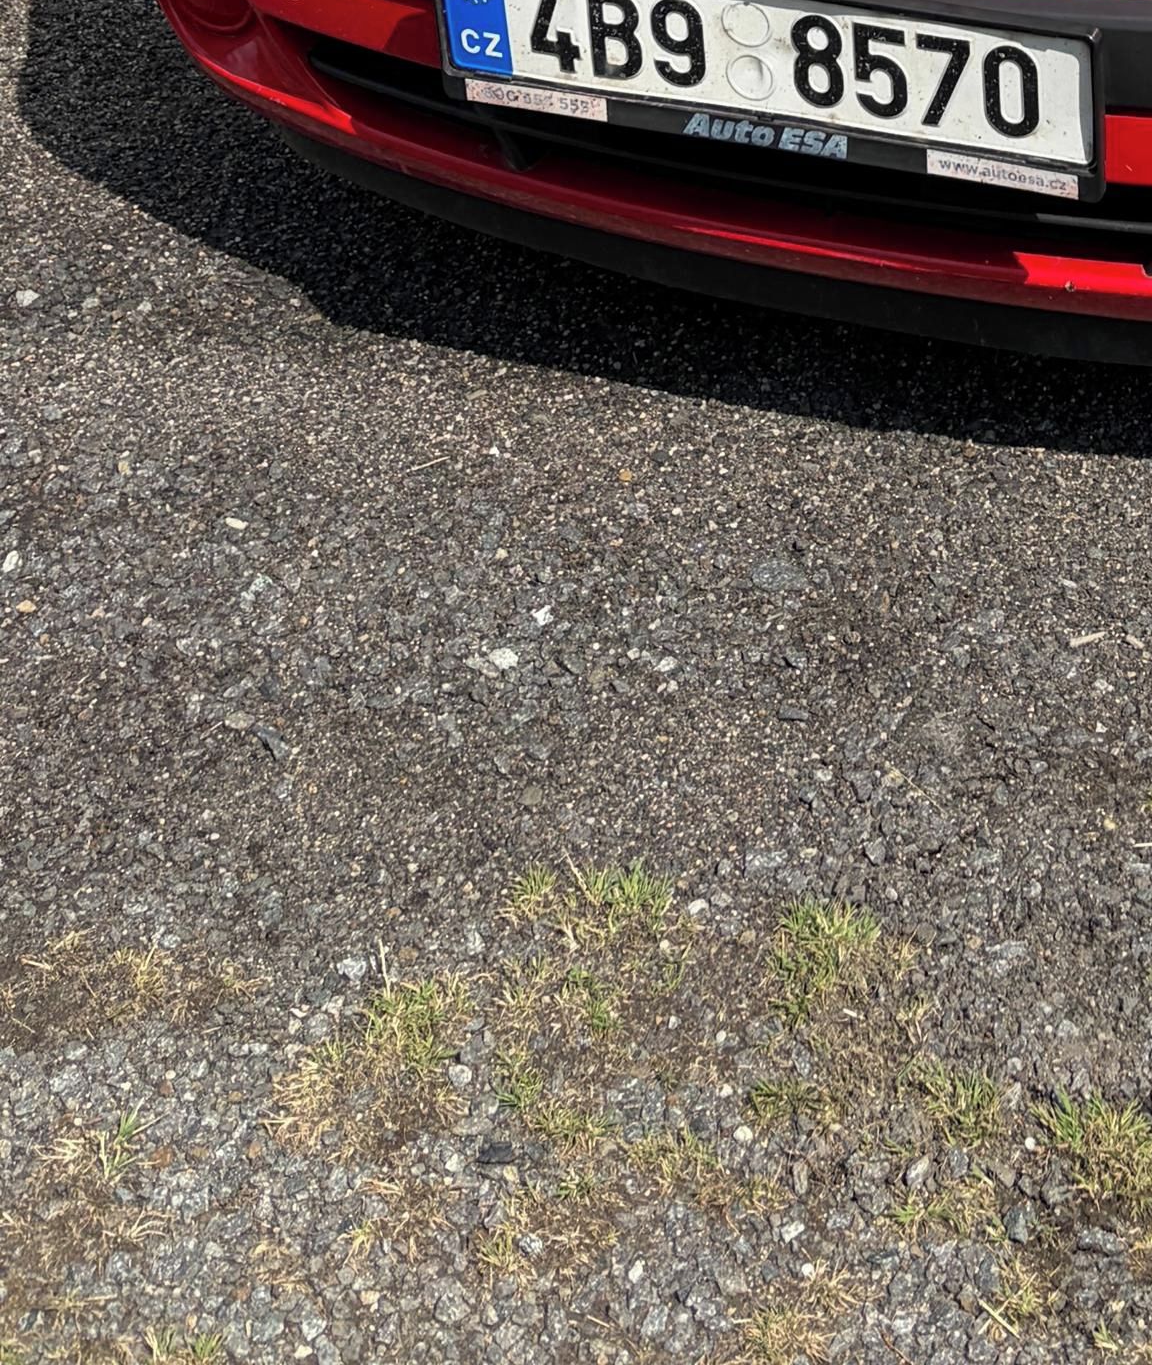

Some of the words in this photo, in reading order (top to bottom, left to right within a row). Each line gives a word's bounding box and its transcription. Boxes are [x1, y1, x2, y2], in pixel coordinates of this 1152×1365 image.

[460, 28, 503, 58] CZ
[790, 14, 1041, 138] 8570
[683, 112, 775, 147] Auto
[778, 127, 849, 160] ESA
